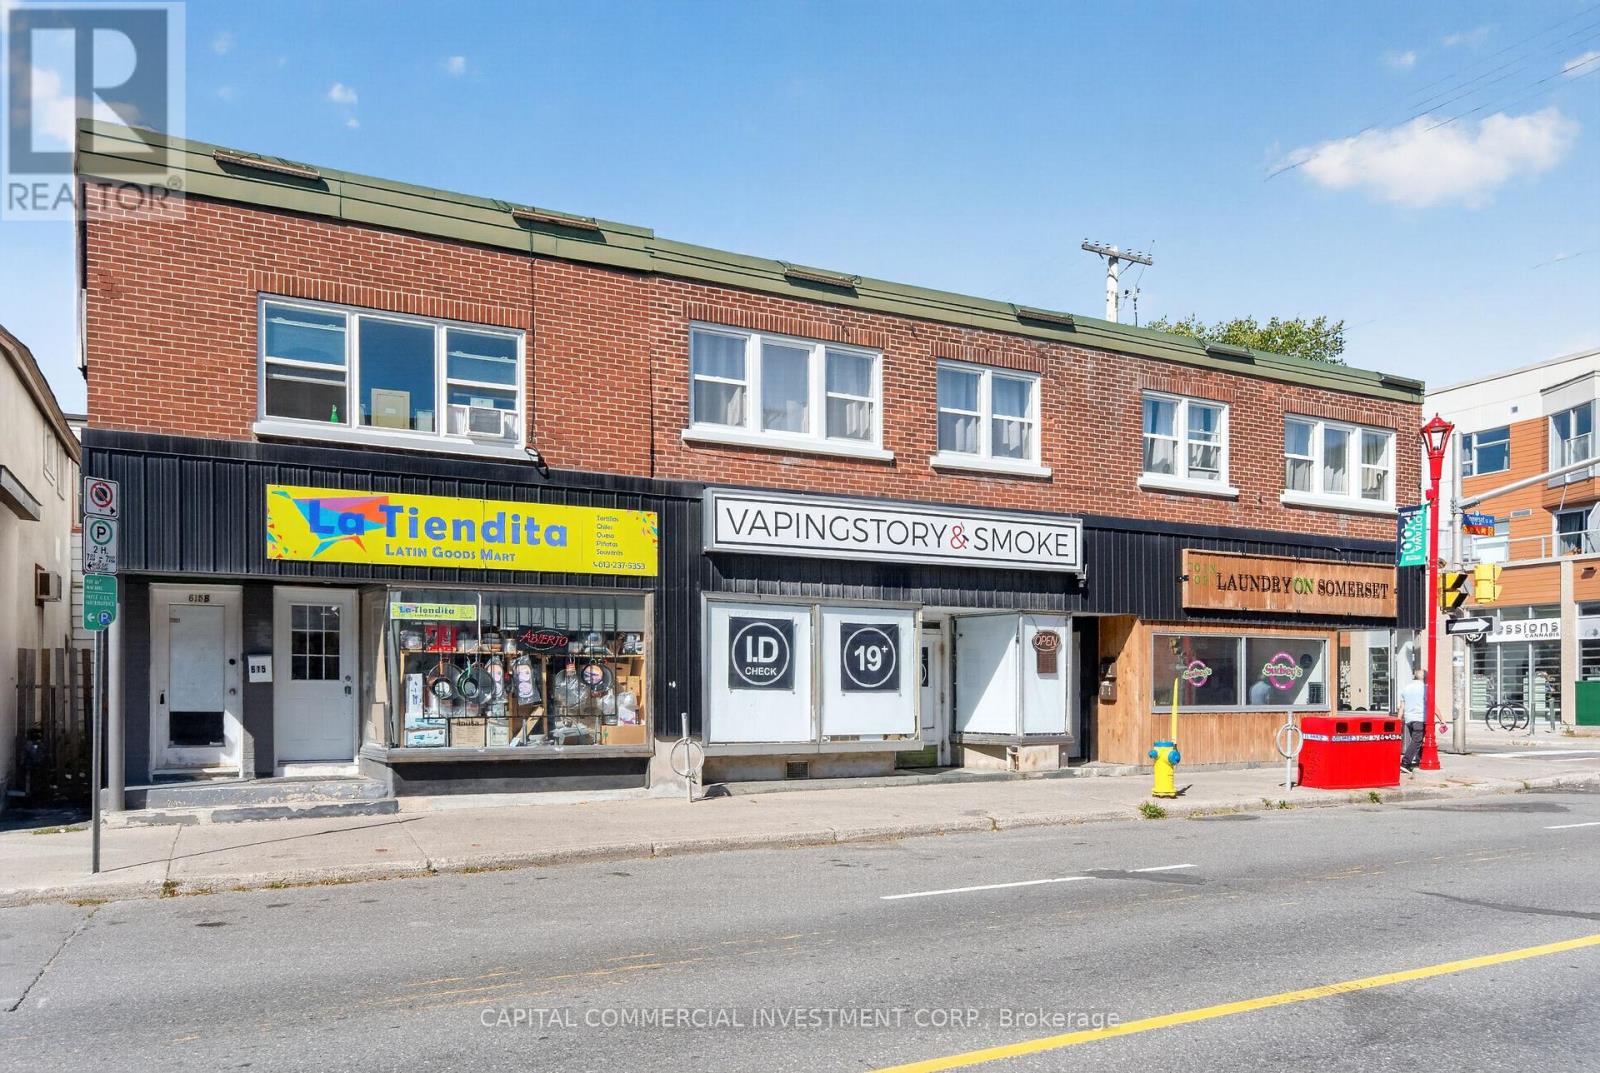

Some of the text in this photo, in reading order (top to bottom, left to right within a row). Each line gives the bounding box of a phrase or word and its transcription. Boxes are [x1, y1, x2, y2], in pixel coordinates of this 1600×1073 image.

[309, 500, 568, 547] La Tiendita
[1216, 572, 1389, 600] LAUNDRY ON SOMERSET
[1488, 622, 1558, 636] essions
[1525, 631, 1560, 639] CANNABIS
[519, 629, 569, 647] ABIERTO
[1034, 635, 1059, 647] OPEN
[745, 666, 777, 677] CHECK
